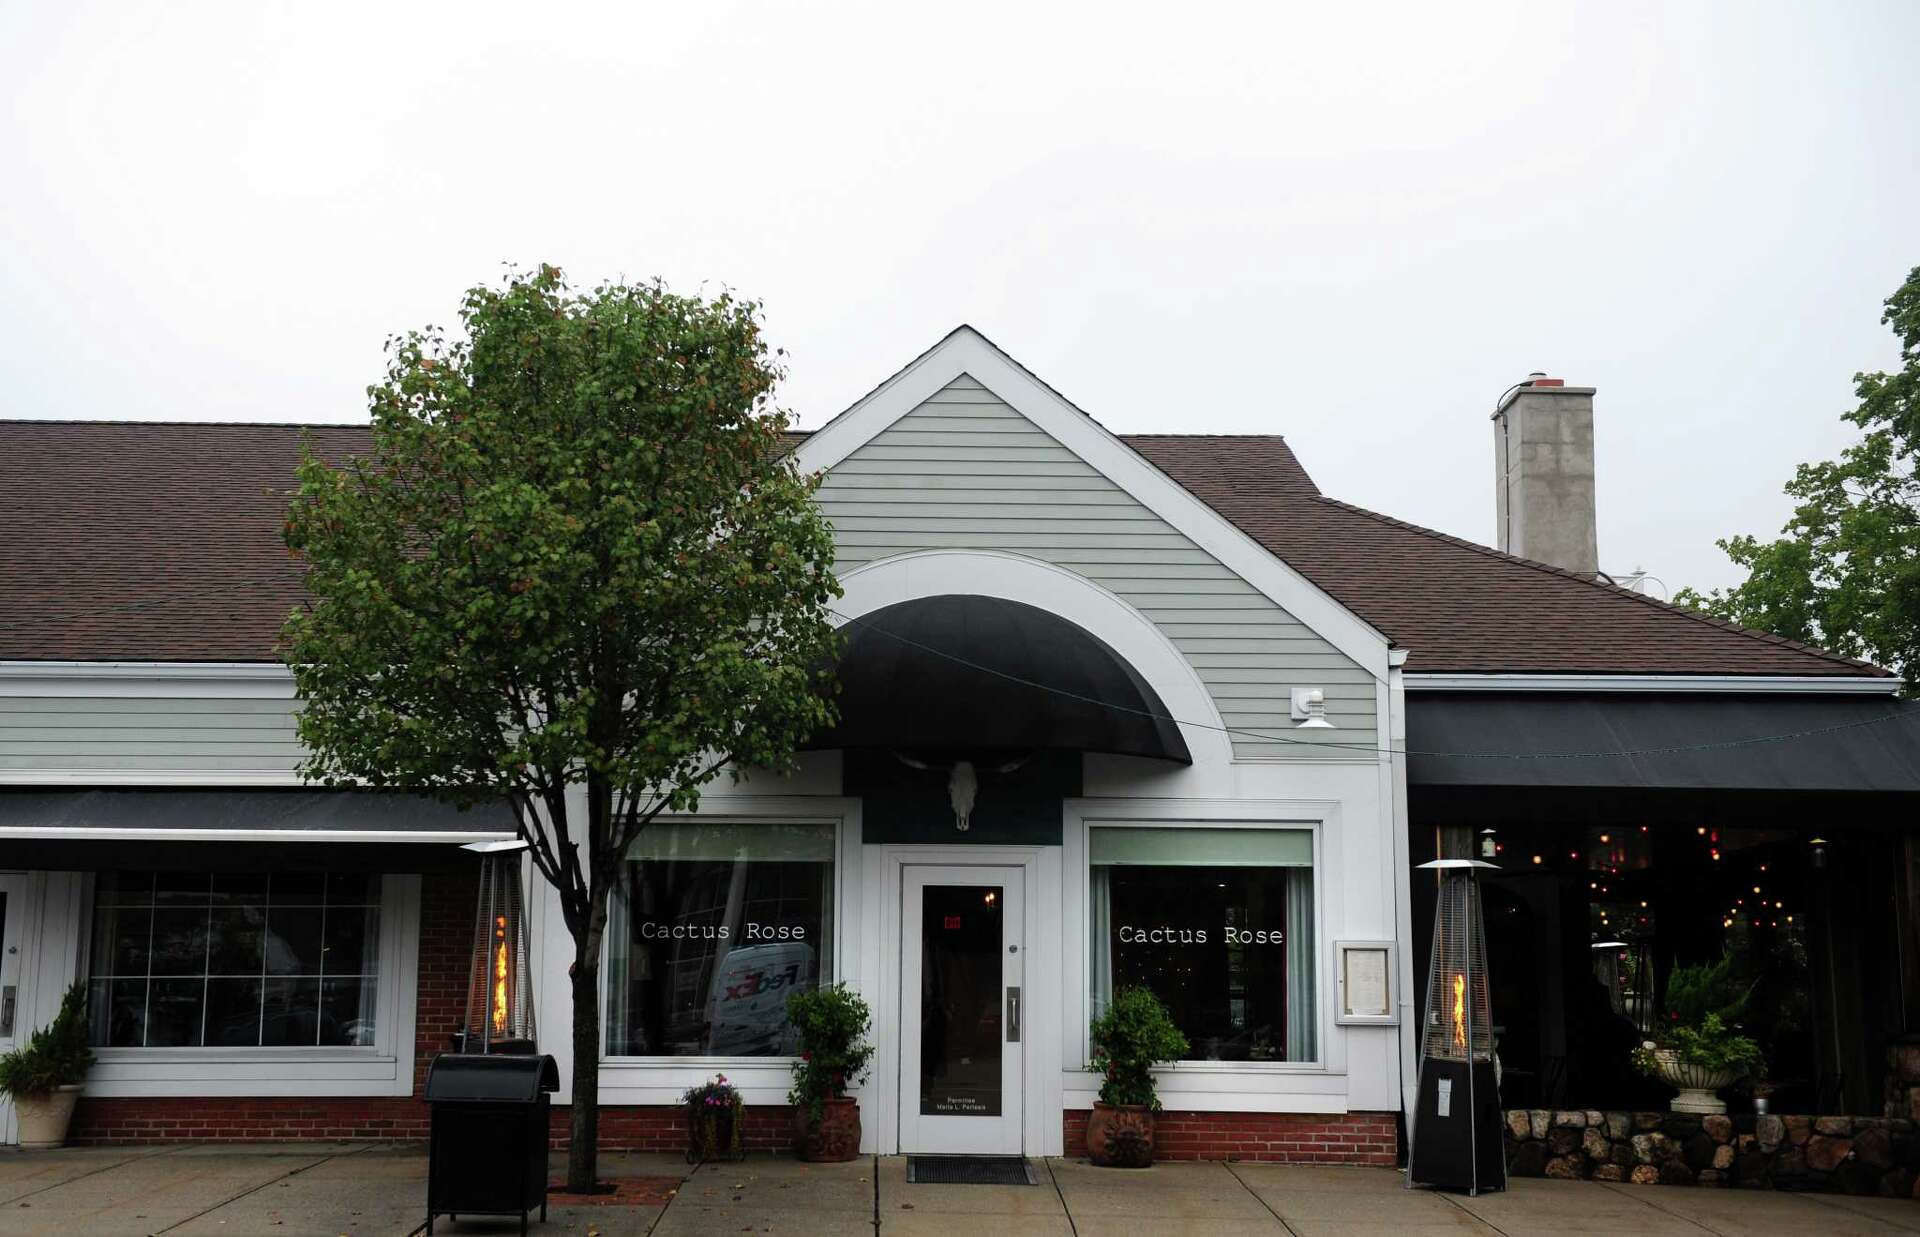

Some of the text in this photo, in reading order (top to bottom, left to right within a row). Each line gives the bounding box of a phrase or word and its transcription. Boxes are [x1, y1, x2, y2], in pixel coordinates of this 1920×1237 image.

[641, 922, 806, 939] Cactus Rose
[1119, 926, 1283, 944] Cactus Rose
